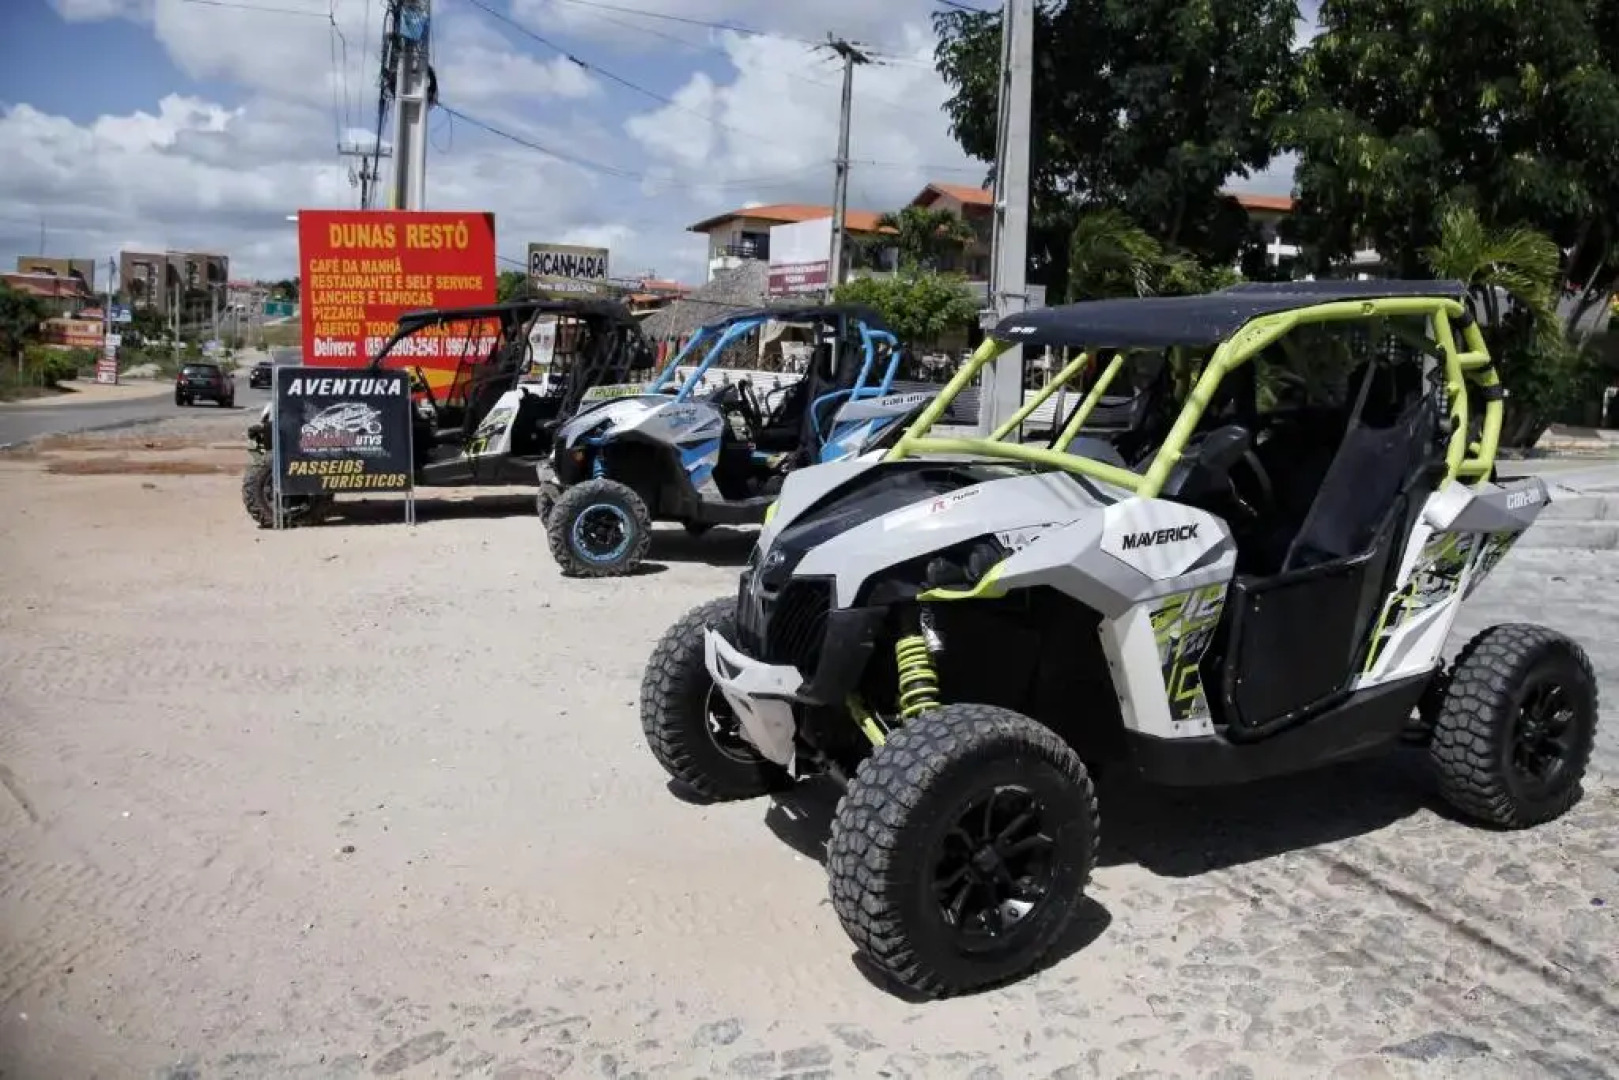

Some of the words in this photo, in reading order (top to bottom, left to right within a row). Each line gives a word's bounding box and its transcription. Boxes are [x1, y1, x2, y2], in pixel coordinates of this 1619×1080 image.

[329, 223, 396, 249] DUNAS
[406, 220, 469, 249] RESTÔ
[310, 257, 340, 273] CAFÉ
[343, 259, 359, 273] DA
[361, 256, 403, 273] MANHÃ
[532, 252, 606, 279] PICANHARIA
[312, 274, 394, 290] RESTAURANTE
[396, 275, 404, 289] E
[406, 275, 434, 290] SELF
[436, 275, 483, 291] SERVICE
[312, 290, 365, 305] LANCHES
[367, 291, 376, 305] E
[378, 291, 434, 306] TAPIOCAS
[313, 306, 366, 320] PIZZARIA
[315, 321, 361, 336] ABERTO
[314, 336, 357, 357] Delivery:
[287, 378, 401, 396] AVENTURA
[288, 460, 365, 476] PASSEIOS
[320, 472, 407, 489] TURÍSTICOS
[1122, 523, 1199, 551] MAVERICK
